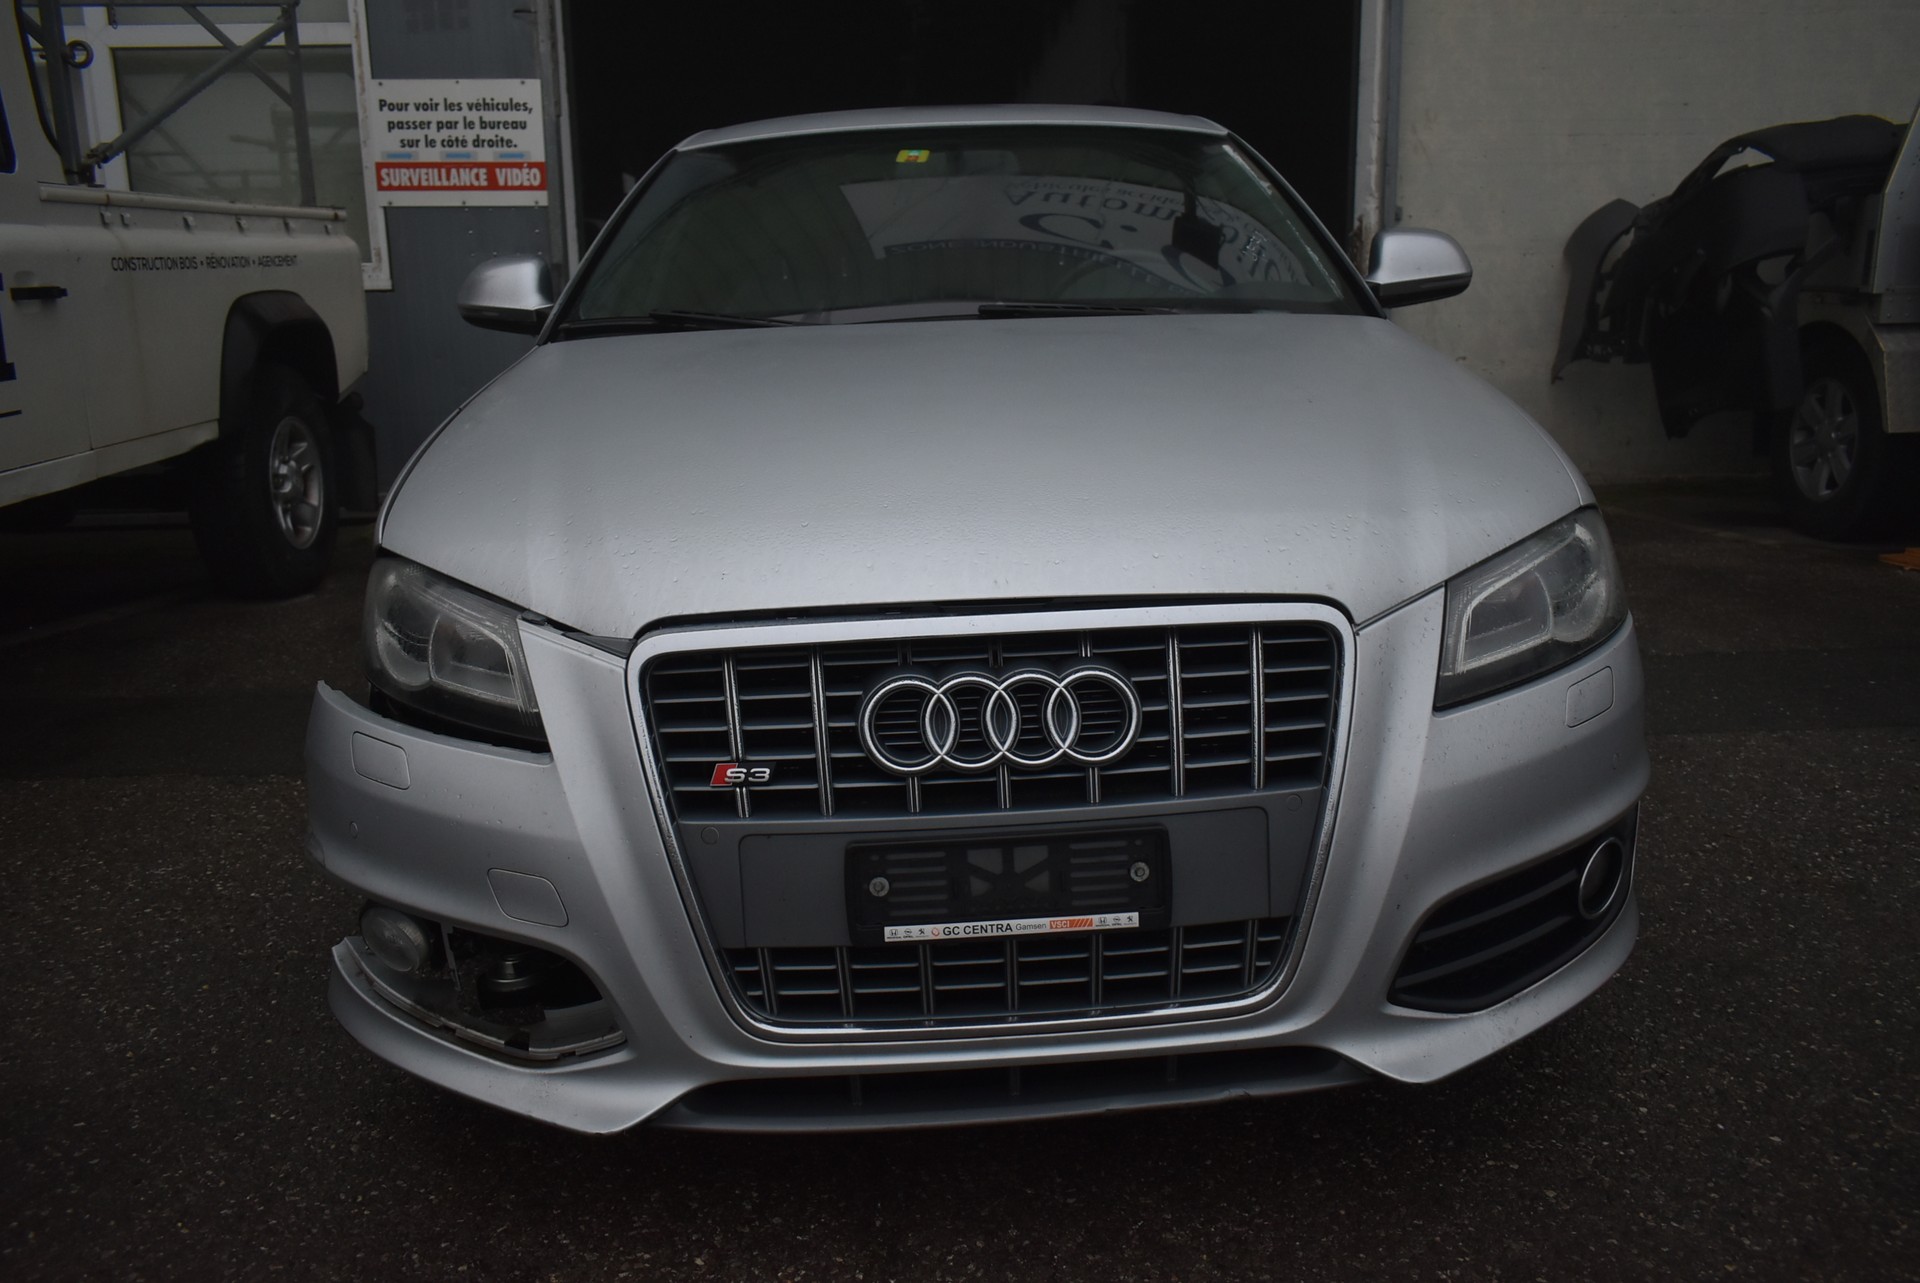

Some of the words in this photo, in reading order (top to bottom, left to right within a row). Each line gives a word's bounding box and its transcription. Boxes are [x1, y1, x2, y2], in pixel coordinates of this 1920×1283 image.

[379, 99, 409, 112] Pour
[414, 98, 440, 112] voir
[444, 98, 463, 112] les
[467, 98, 533, 114] véhicules,
[387, 119, 432, 133] passer
[436, 119, 460, 133] par
[464, 116, 475, 130] le
[480, 116, 527, 130] bureau
[400, 138, 420, 148] sur
[425, 134, 436, 148] le
[441, 134, 468, 148] côté
[472, 134, 518, 148] droite.
[380, 167, 488, 187] SURVEILLANCE
[495, 163, 542, 187] VIDÉO
[111, 256, 178, 271] CONSTRUCTION
[179, 256, 198, 270] BOIS
[206, 253, 250, 269] RÉNOVATION
[258, 254, 298, 268] AGENCEMENT
[724, 767, 770, 783] S3
[943, 926, 960, 936] GC
[963, 923, 1013, 935] CENTRA
[1016, 922, 1047, 931] Gamsen
[1051, 920, 1070, 928] VSCI
